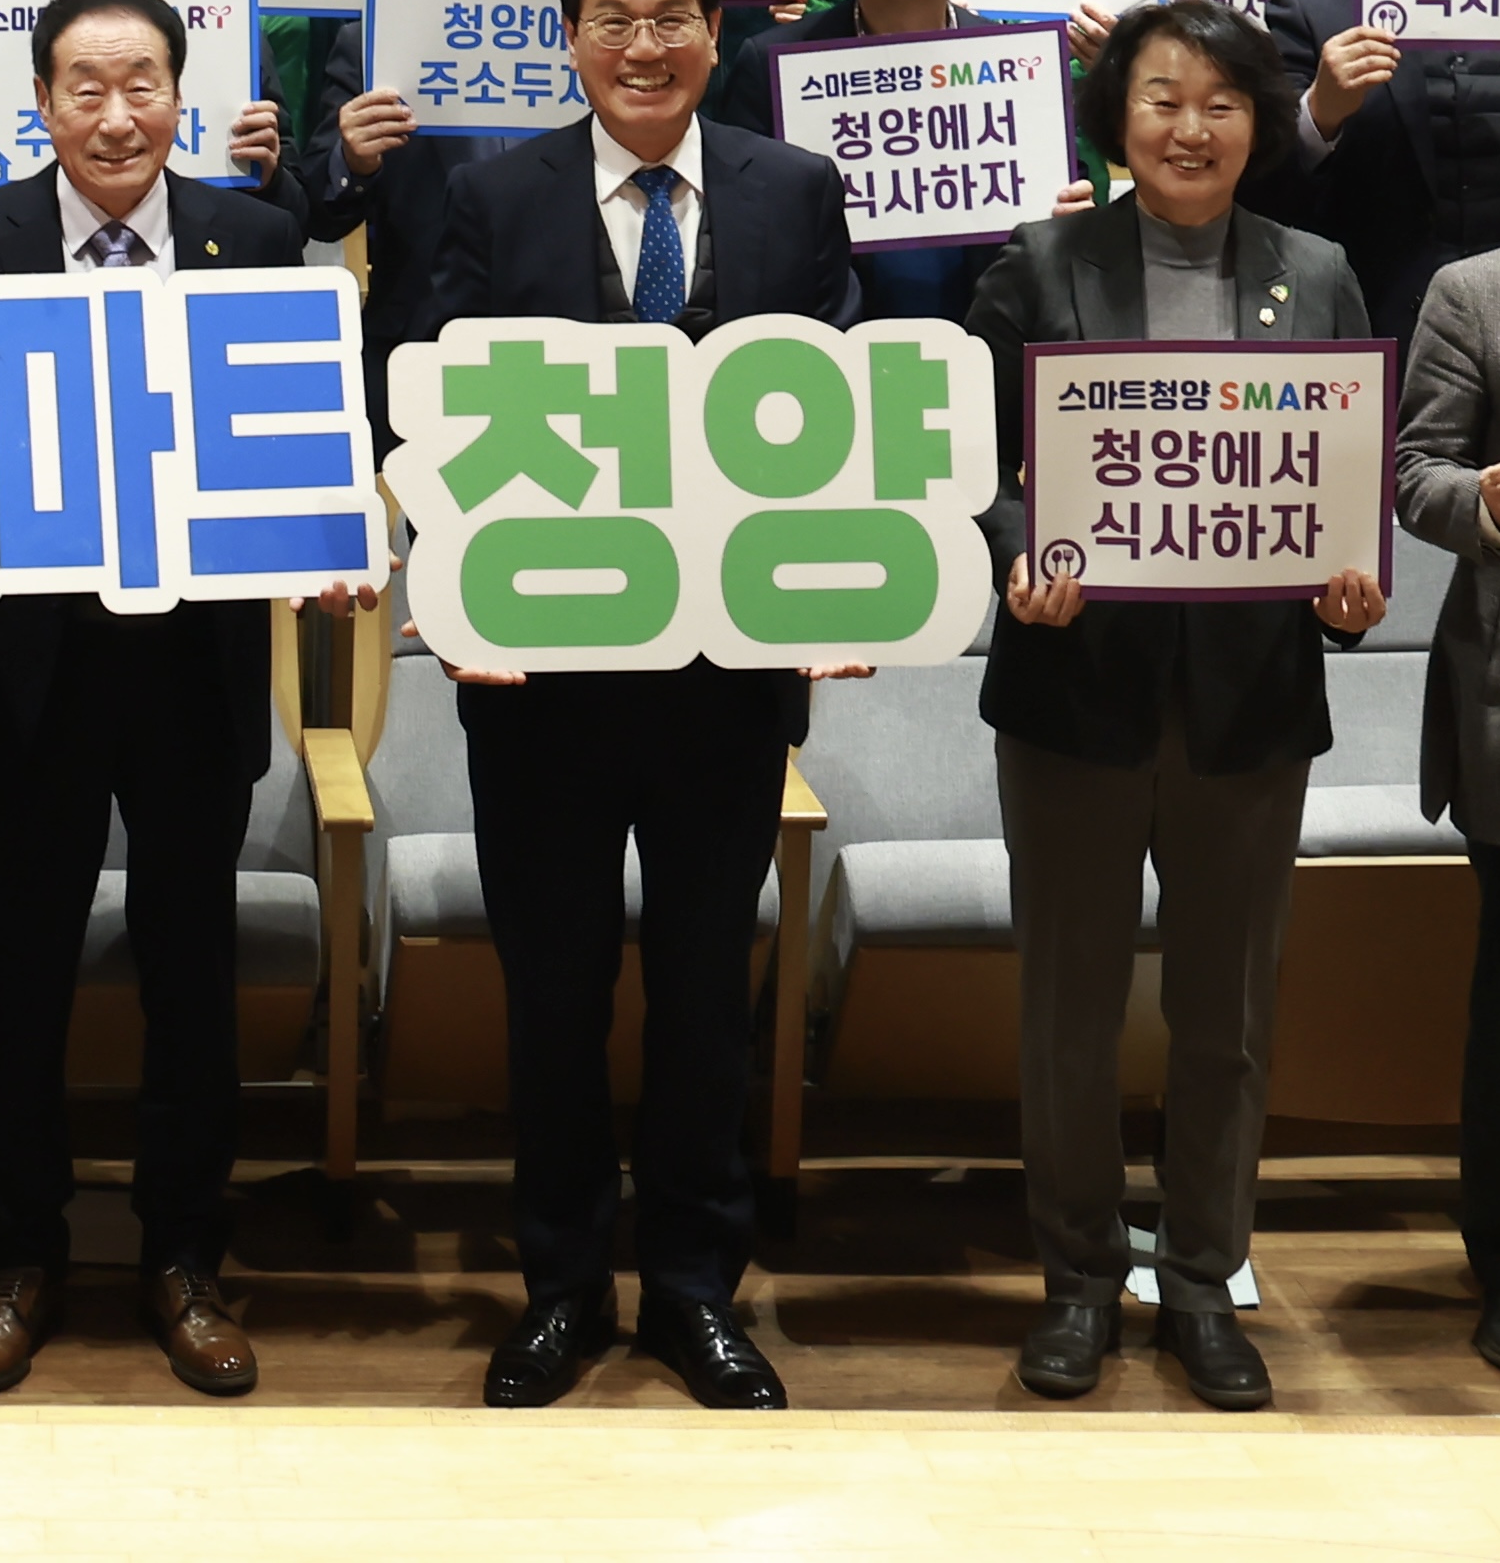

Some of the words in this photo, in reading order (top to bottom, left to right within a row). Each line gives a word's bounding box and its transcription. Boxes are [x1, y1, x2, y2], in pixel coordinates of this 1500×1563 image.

[801, 65, 923, 100] 스마트청양
[832, 100, 1016, 160] 청양에서
[1058, 380, 1210, 411] 스마트청양
[1092, 428, 1319, 488] 청양에서
[438, 338, 952, 648] 청양
[1091, 502, 1323, 560] 식사하자
